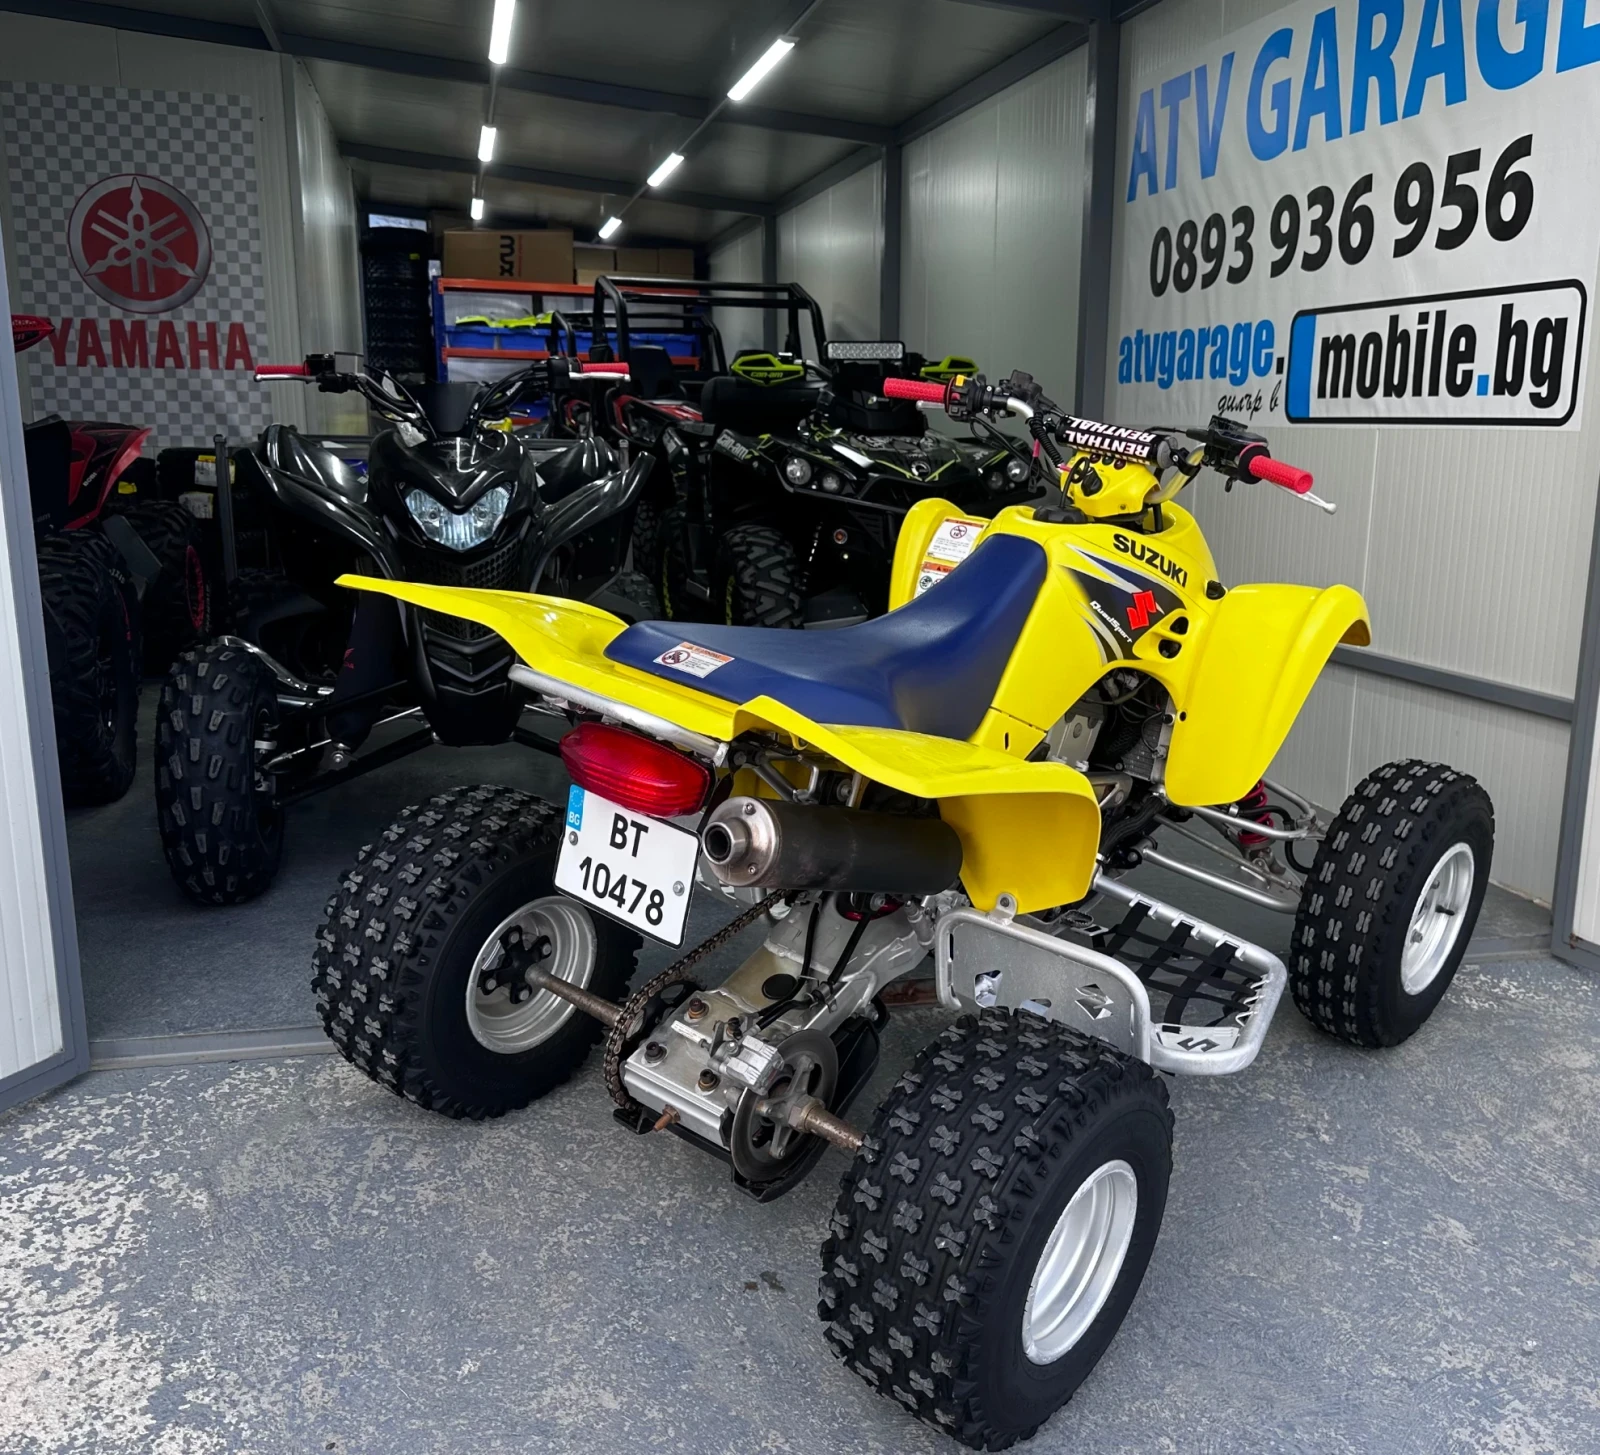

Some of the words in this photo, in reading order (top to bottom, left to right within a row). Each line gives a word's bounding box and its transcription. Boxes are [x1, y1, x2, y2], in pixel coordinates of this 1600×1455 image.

[1127, 51, 1235, 203] ATV
[1150, 205, 1255, 298] 0893
[1270, 173, 1374, 279] 936
[1393, 134, 1534, 258] 956
[42, 317, 254, 371] YAMAHA
[1317, 303, 1569, 408] mobile.bg
[1065, 430, 1150, 458] RENTHAL
[1068, 416, 1157, 443] RENTHAL
[1113, 533, 1188, 588] SUZUKI
[1089, 600, 1133, 643] QuadSport
[568, 811, 580, 826] BG
[609, 812, 649, 858] BT
[579, 856, 665, 926] 10478
